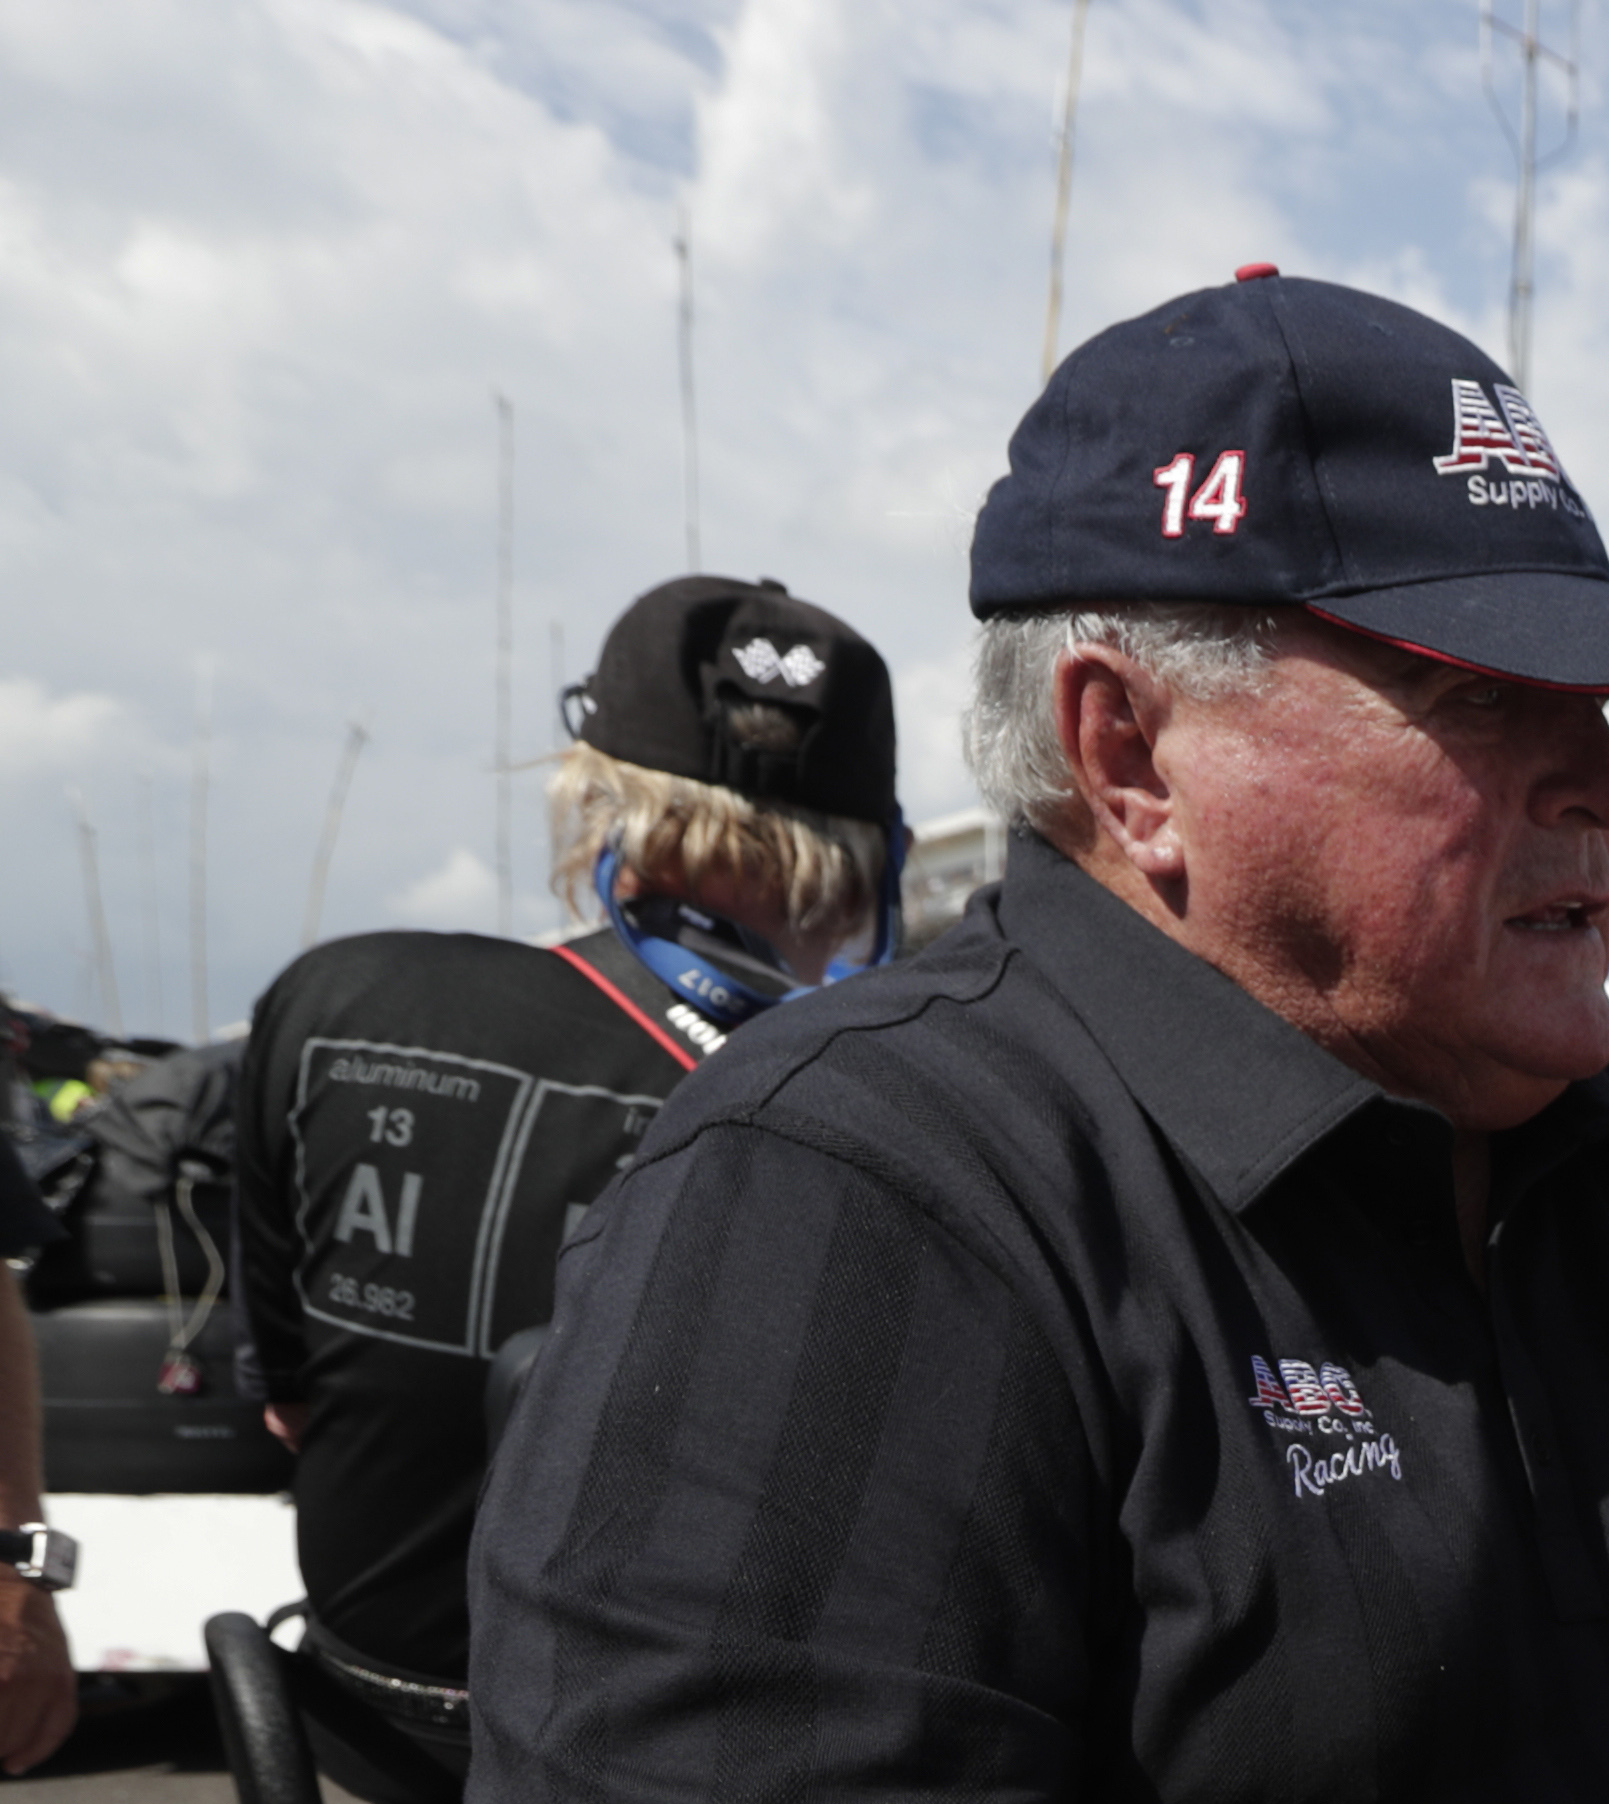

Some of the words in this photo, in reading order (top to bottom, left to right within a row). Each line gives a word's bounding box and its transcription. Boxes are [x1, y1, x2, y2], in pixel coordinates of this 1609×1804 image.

[1154, 450, 1248, 539] 14
[1467, 475, 1558, 510] Supply
[329, 1056, 481, 1102] aluminum
[366, 1106, 415, 1148] 13
[333, 1163, 424, 1259] Al
[328, 1272, 415, 1322] 26.982
[1248, 1354, 1365, 1416] ABC
[1317, 1415, 1348, 1434] Co.
[1286, 1433, 1402, 1498] Racing
